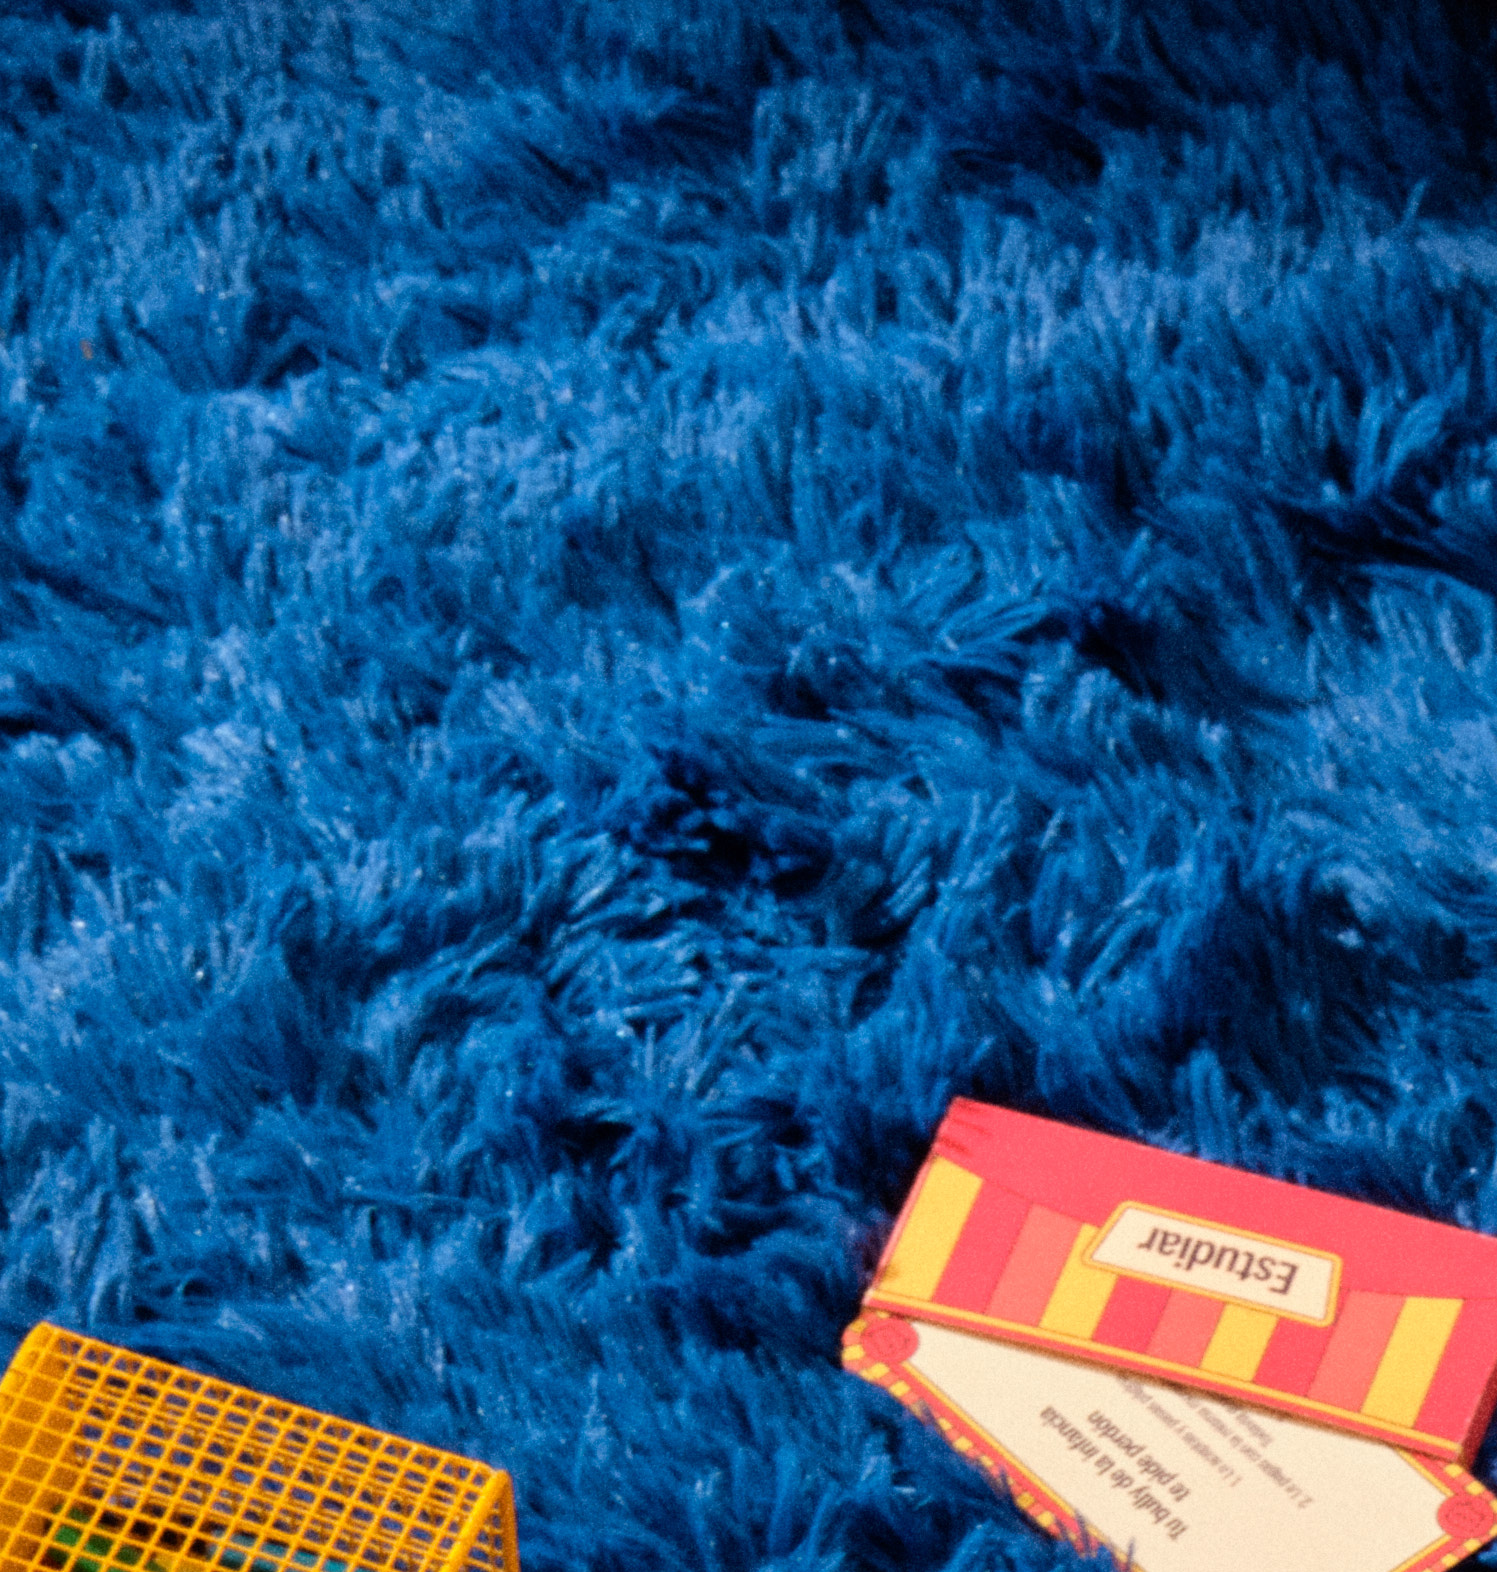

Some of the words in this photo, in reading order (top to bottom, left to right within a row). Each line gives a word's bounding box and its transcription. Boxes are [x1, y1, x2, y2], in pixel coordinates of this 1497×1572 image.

[1137, 1227, 1299, 1296] Estudiar
[1039, 1405, 1100, 1460] infancia
[1087, 1410, 1146, 1459] perdón
[1094, 1454, 1116, 1476] la
[1110, 1469, 1135, 1489] de
[1136, 1455, 1178, 1486] pide
[1129, 1485, 1171, 1525] bully
[1168, 1483, 1190, 1503] te
[1165, 1517, 1188, 1541] Tu
